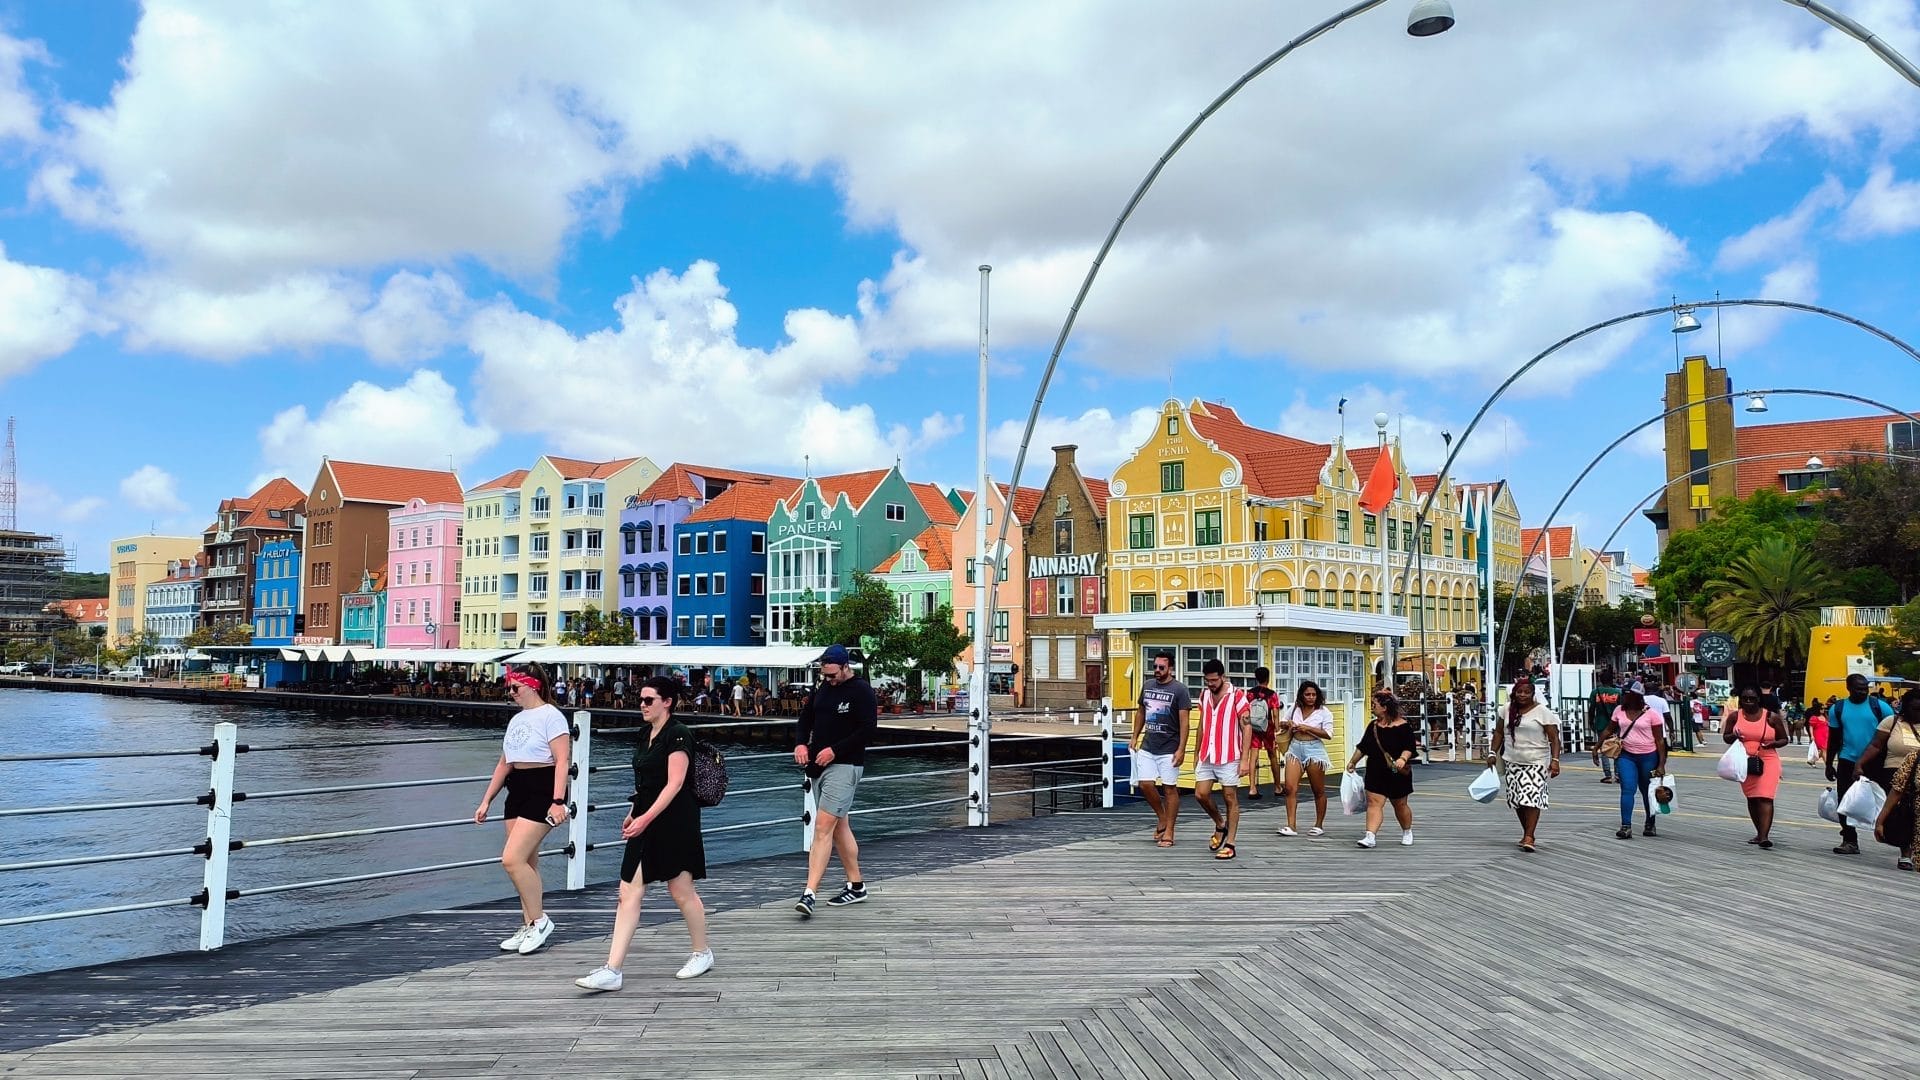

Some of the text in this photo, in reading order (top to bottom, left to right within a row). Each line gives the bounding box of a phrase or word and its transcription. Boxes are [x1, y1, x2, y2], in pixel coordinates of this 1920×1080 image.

[1158, 446, 1190, 457] PENHA
[778, 519, 842, 536] PANERAI
[1028, 552, 1099, 579] ANNABAY
[294, 636, 322, 645] FERRY
